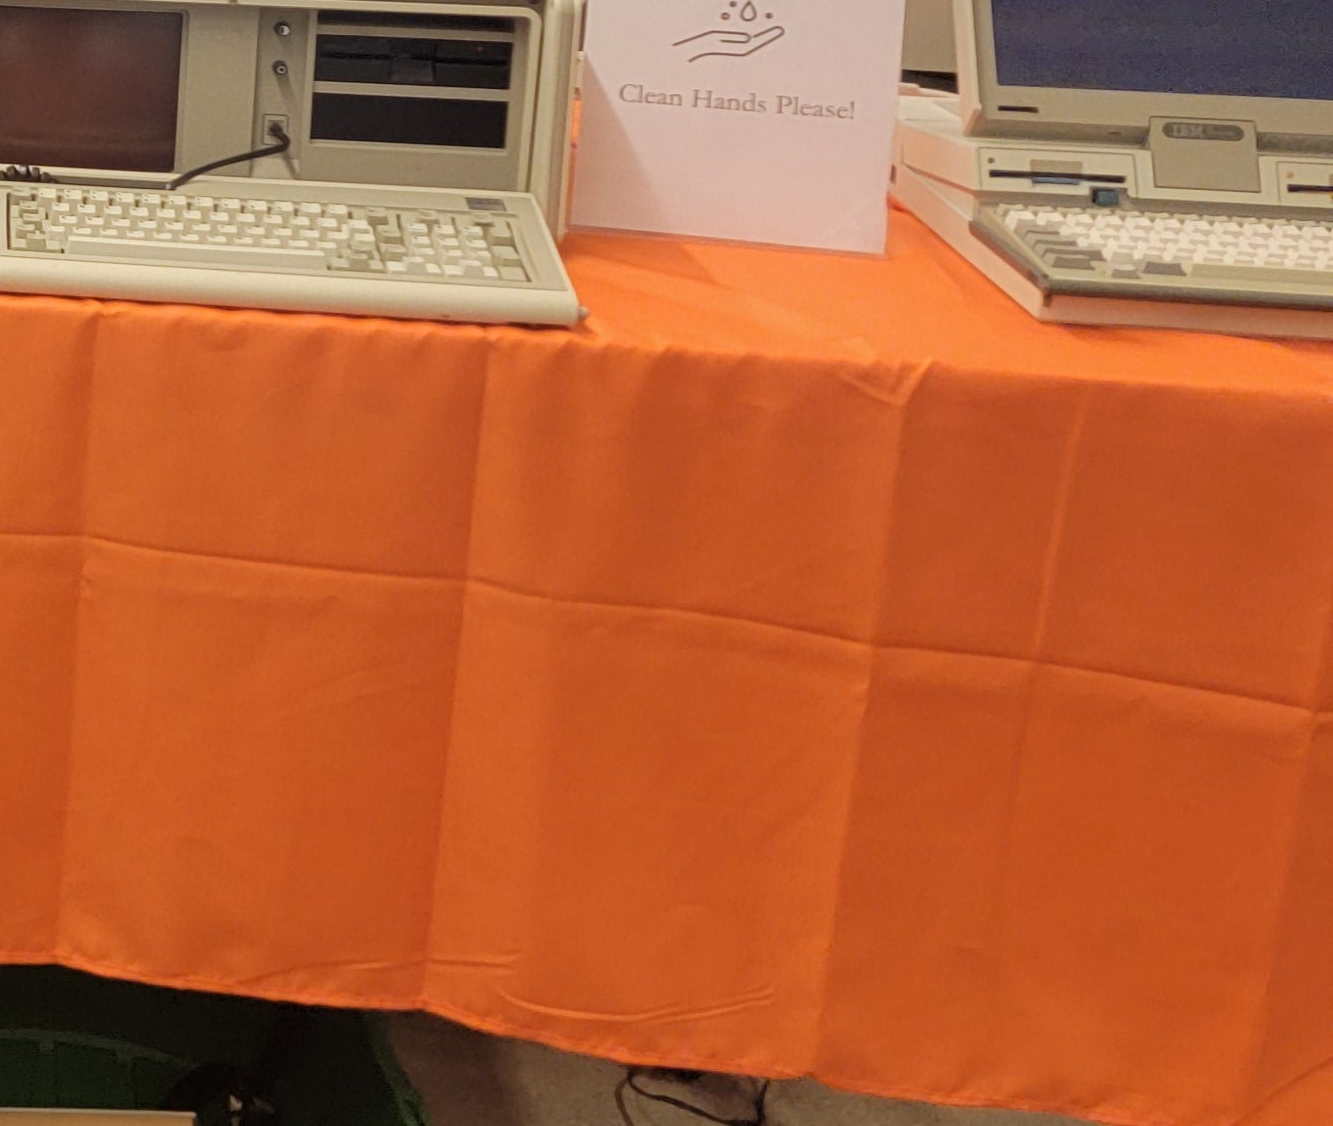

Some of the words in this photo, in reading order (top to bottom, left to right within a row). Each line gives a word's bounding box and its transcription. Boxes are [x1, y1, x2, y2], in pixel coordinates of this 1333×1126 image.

[618, 83, 684, 106] Clean
[692, 89, 767, 113] Hands
[775, 94, 856, 120] Please!
